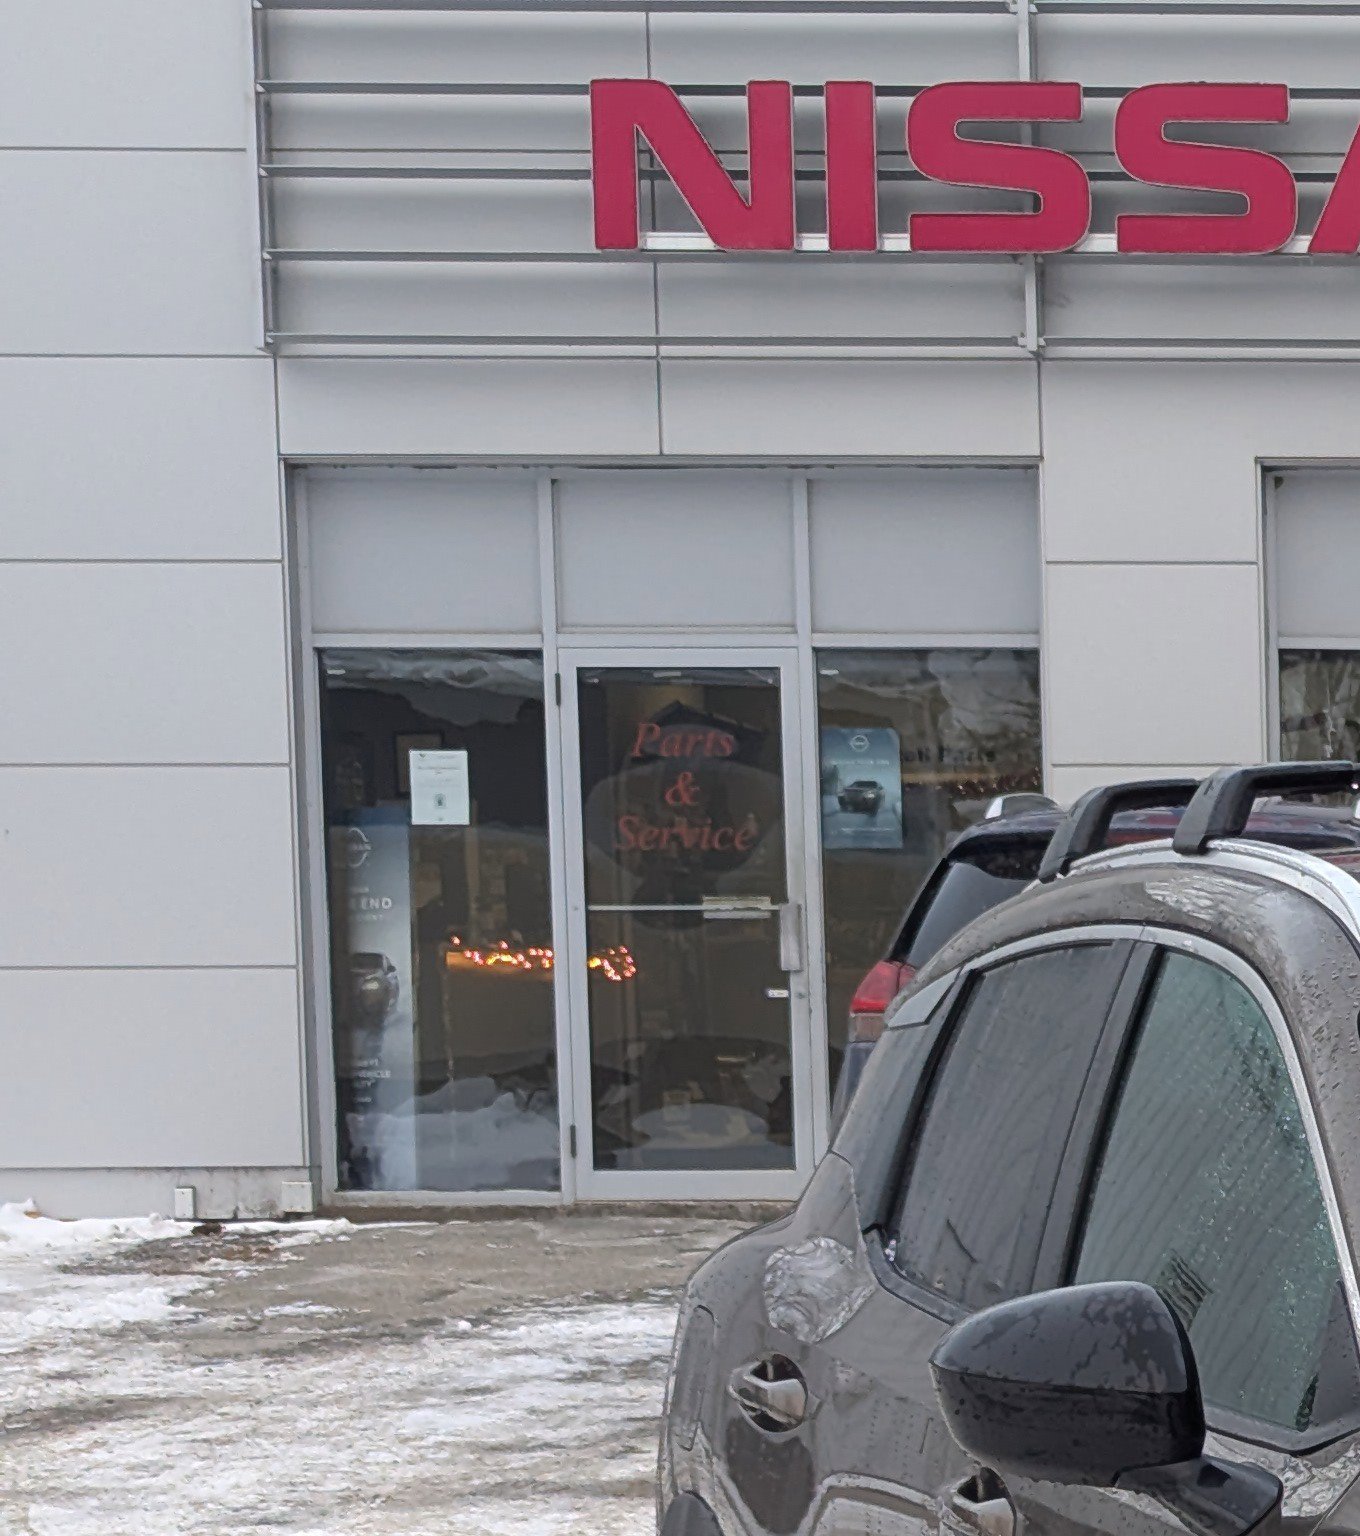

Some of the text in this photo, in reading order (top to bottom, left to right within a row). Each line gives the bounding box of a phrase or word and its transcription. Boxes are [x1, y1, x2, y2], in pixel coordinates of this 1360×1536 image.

[631, 723, 735, 757] Parts
[665, 772, 700, 805] &
[613, 814, 757, 850] Service
